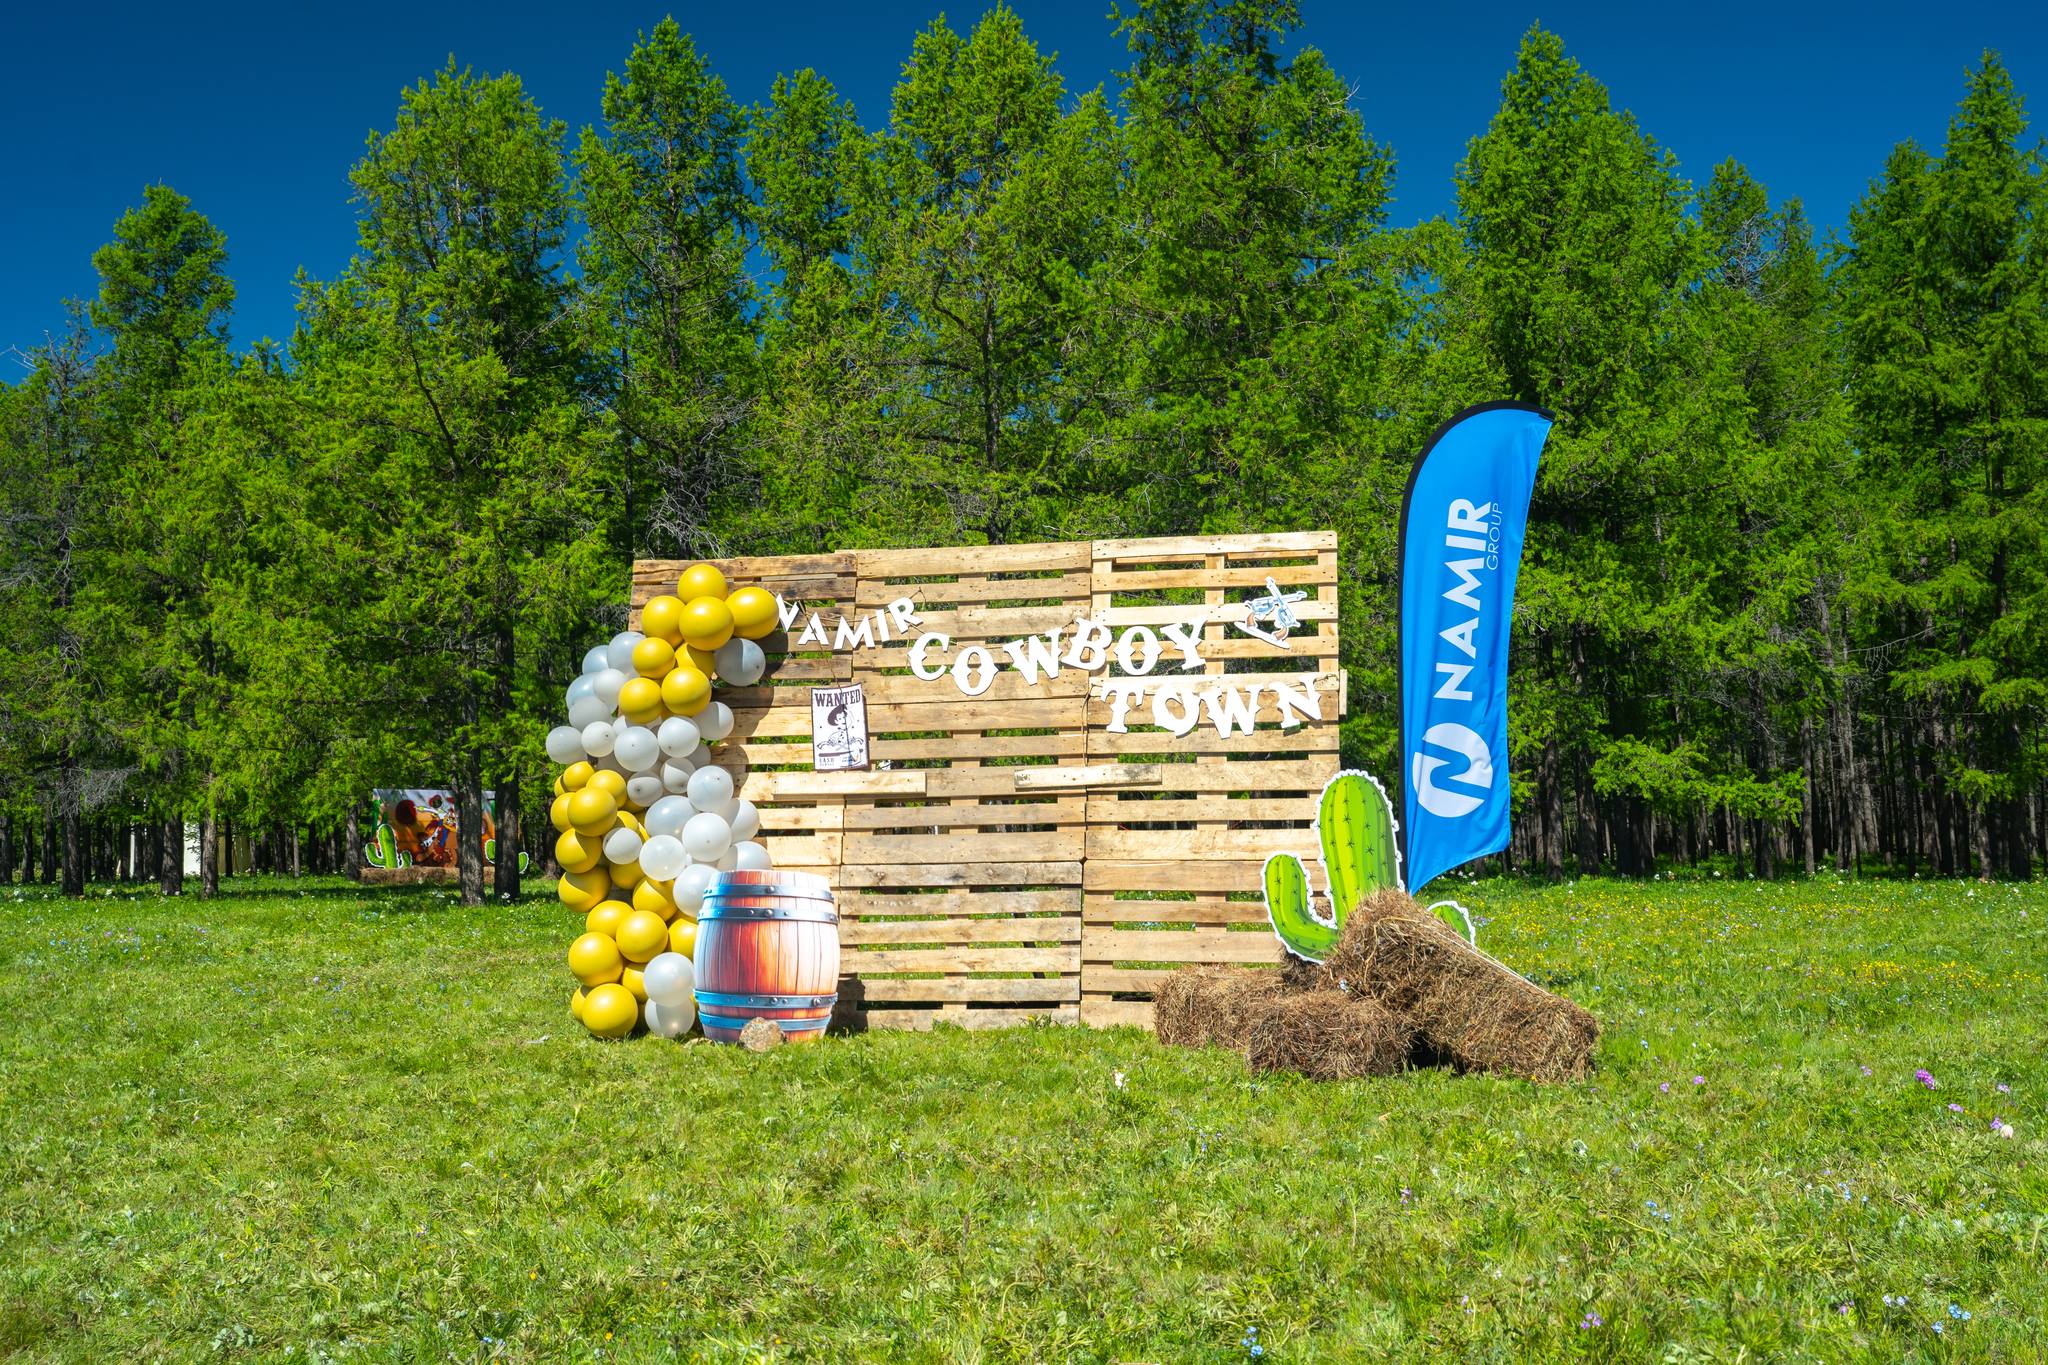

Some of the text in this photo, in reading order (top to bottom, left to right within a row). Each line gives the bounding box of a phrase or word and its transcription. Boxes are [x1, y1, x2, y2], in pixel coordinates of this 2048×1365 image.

[1486, 502, 1502, 570] GROUP
[1434, 498, 1491, 701] NAMIR
[907, 616, 1207, 696] COWBOY
[814, 689, 860, 707] WANTED
[1100, 672, 1323, 738] TOWN
